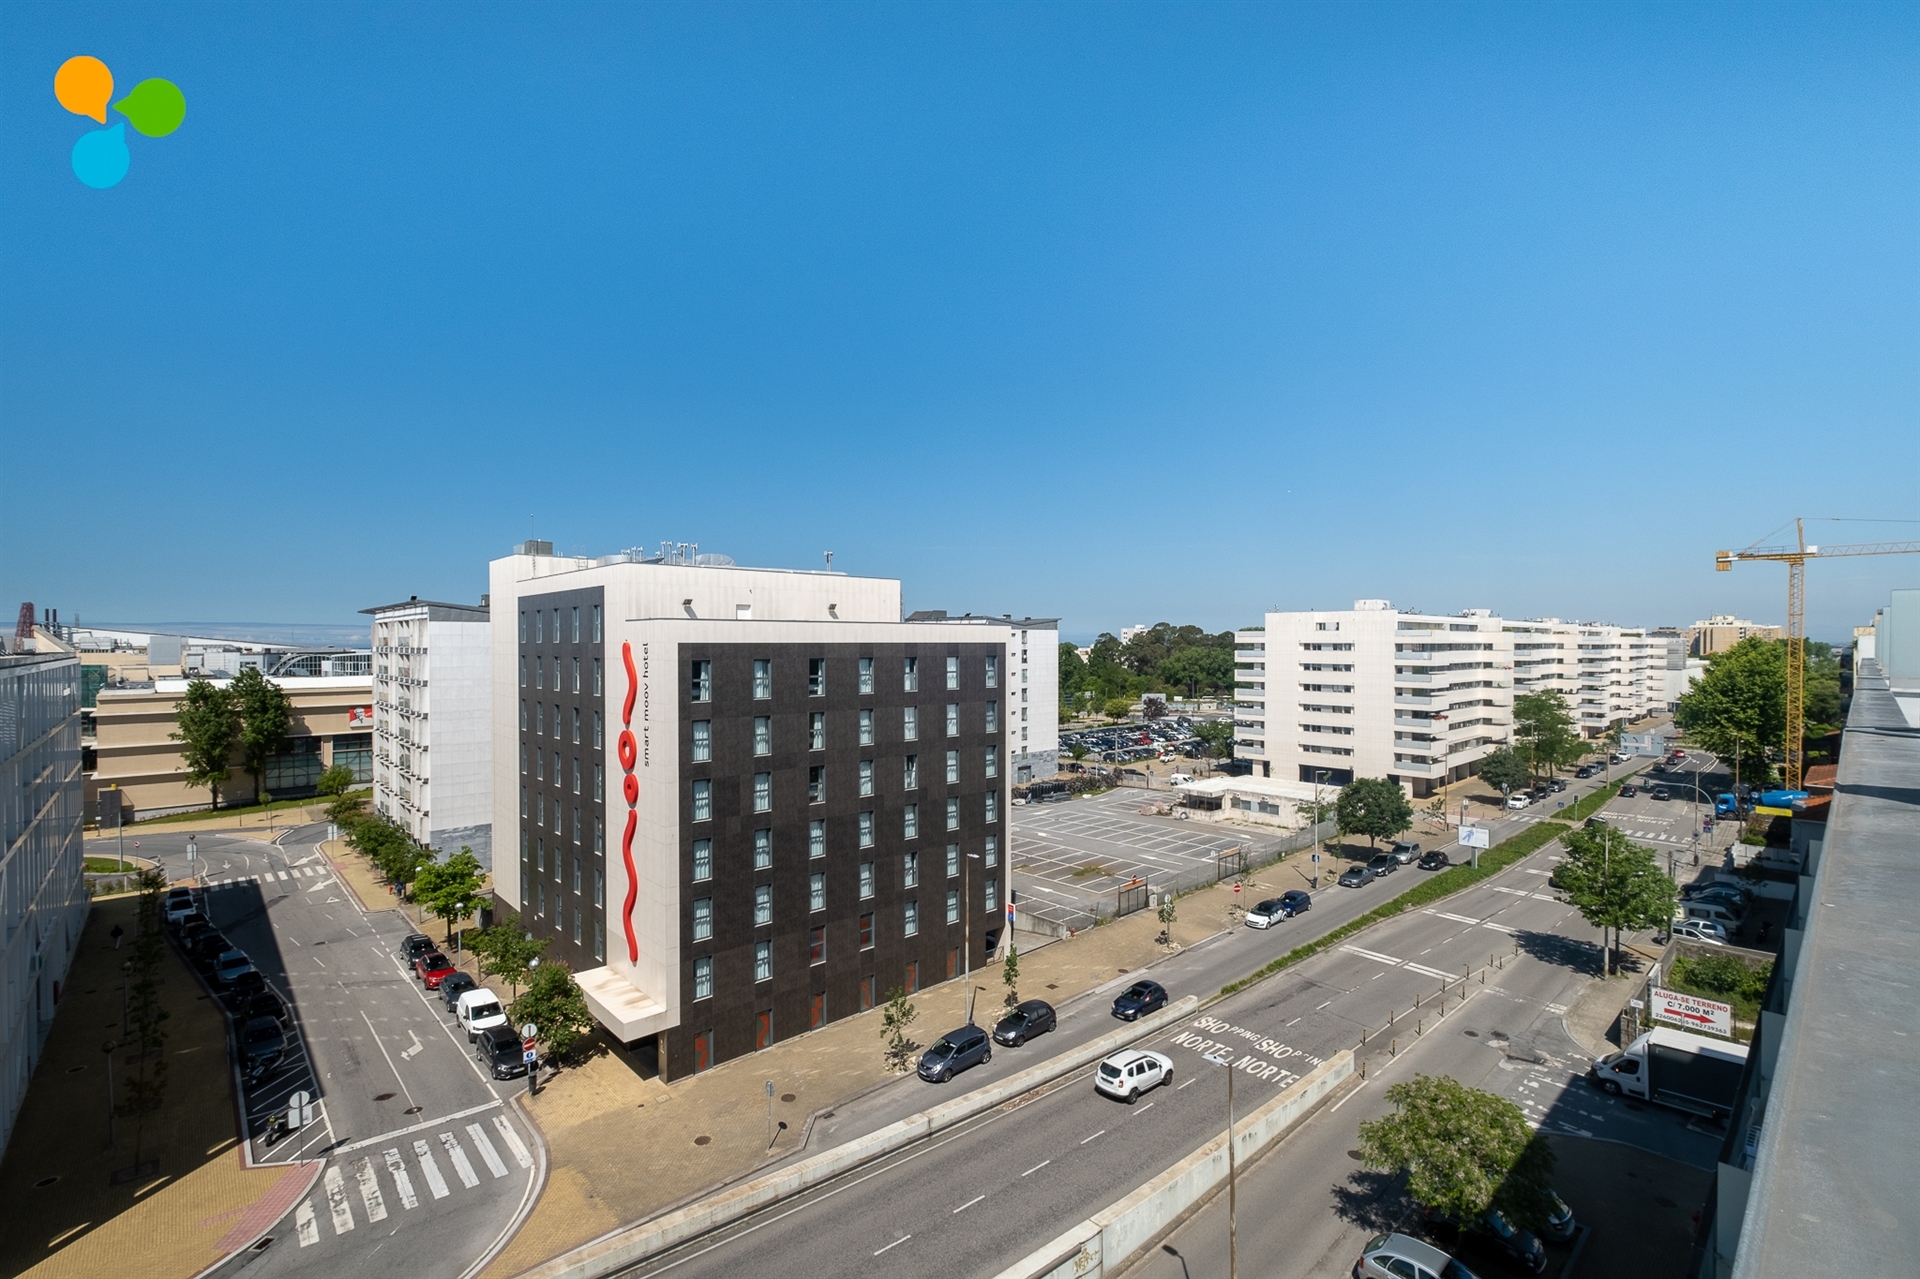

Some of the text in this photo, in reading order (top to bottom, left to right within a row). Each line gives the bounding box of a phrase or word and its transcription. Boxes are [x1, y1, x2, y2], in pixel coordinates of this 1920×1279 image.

[1654, 990, 1690, 1005] ALUGA-SE
[1692, 999, 1728, 1013] TERRENO
[1678, 1002, 1700, 1014] 7.000
[1193, 1016, 1261, 1042] SHOPPING
[1655, 1012, 1690, 1025] 22600625
[1170, 1031, 1234, 1059] NORTE
[1255, 1038, 1327, 1068] SHOPIN
[1232, 1055, 1301, 1089] NORTE
